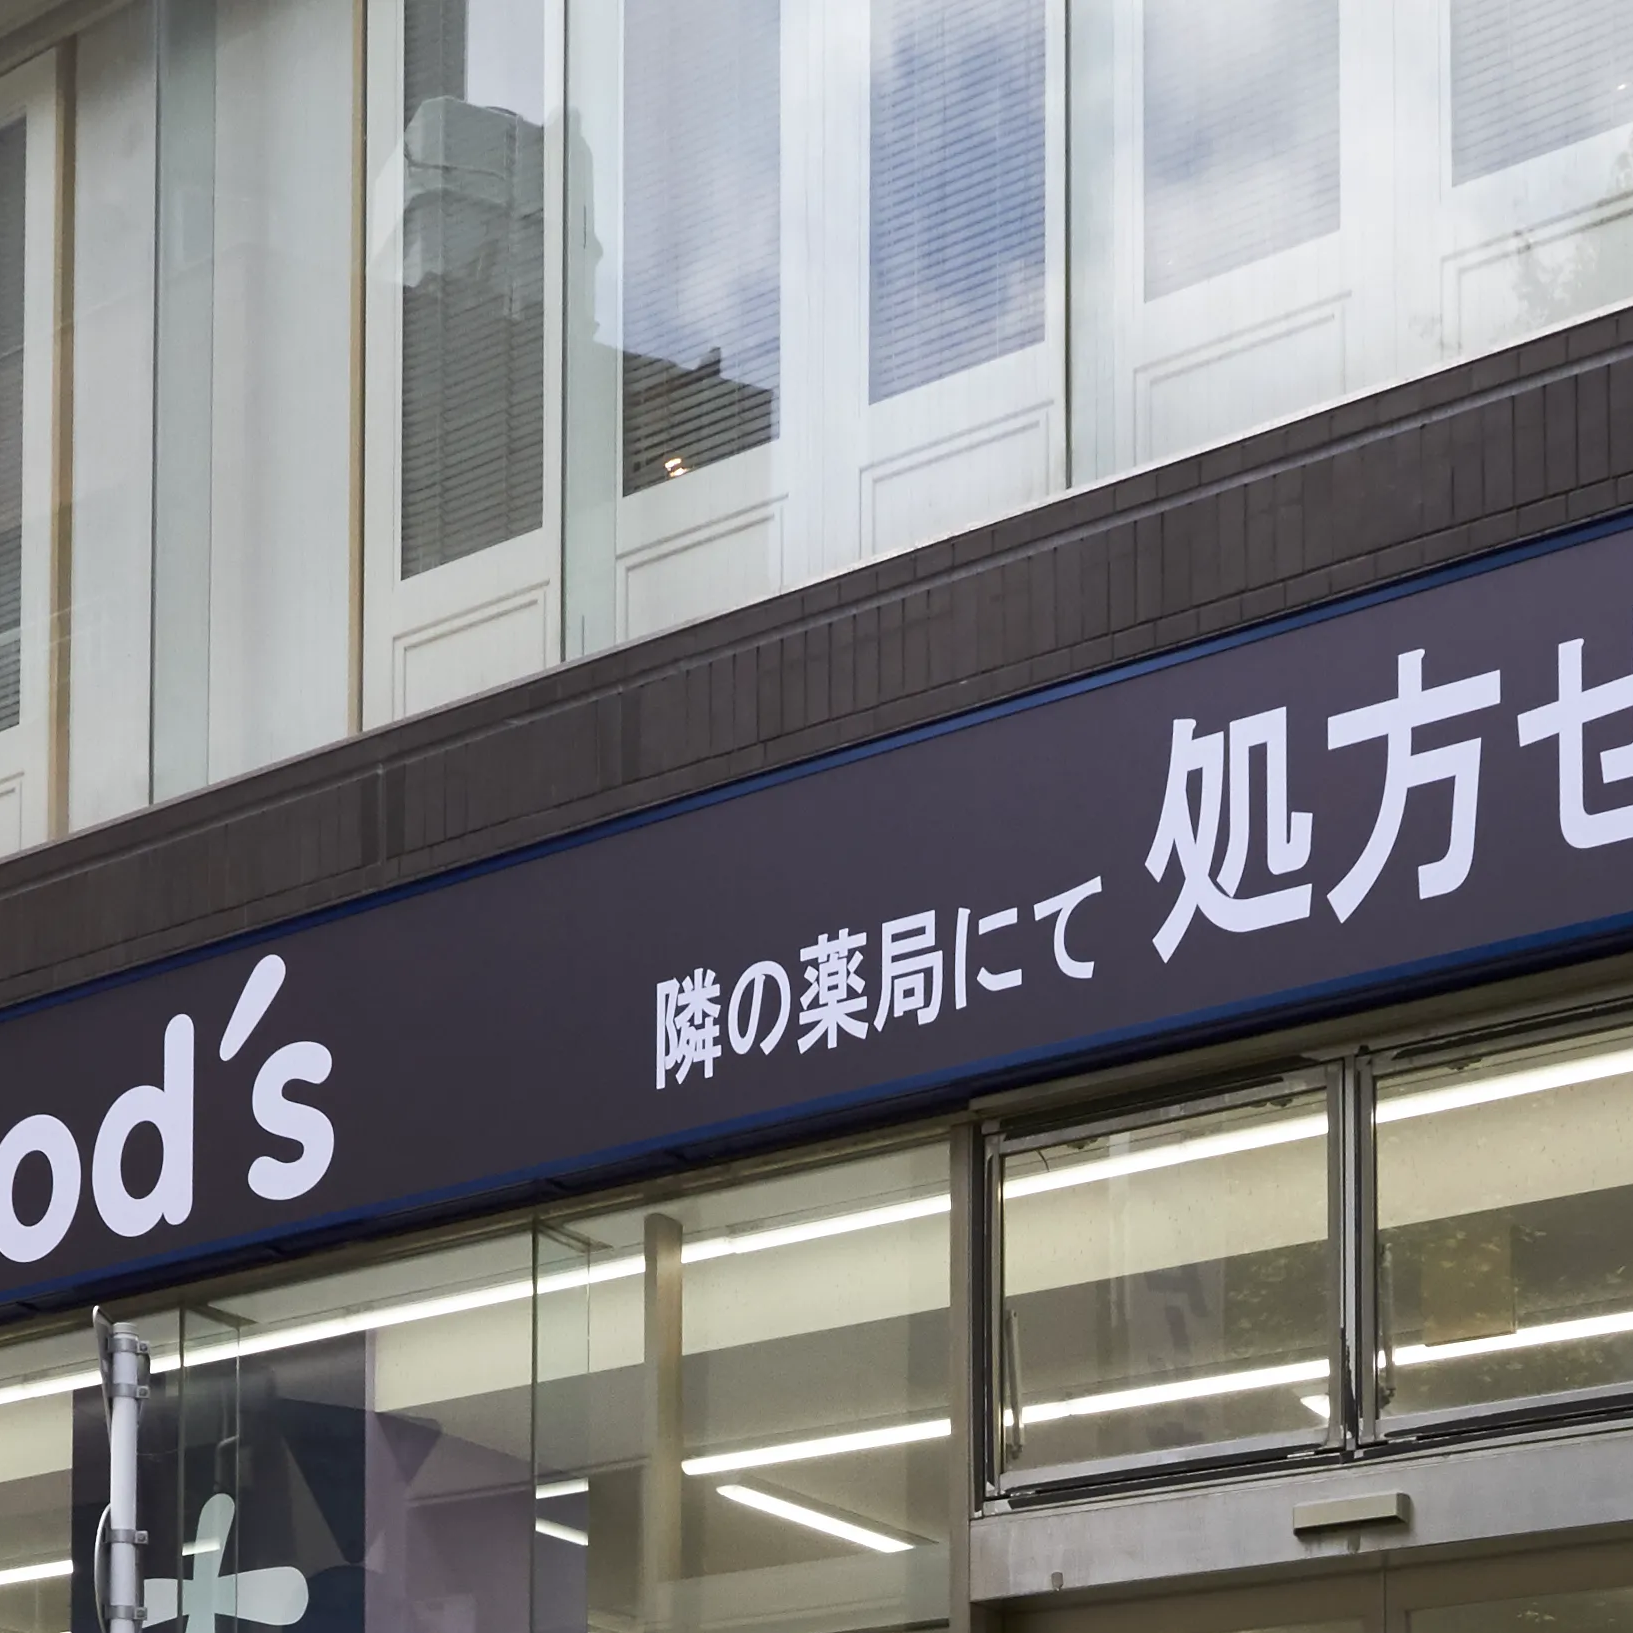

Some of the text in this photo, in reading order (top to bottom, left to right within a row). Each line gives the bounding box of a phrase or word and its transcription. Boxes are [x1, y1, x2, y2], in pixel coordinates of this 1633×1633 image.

[654, 875, 1103, 1090] 隣の薬局にて
